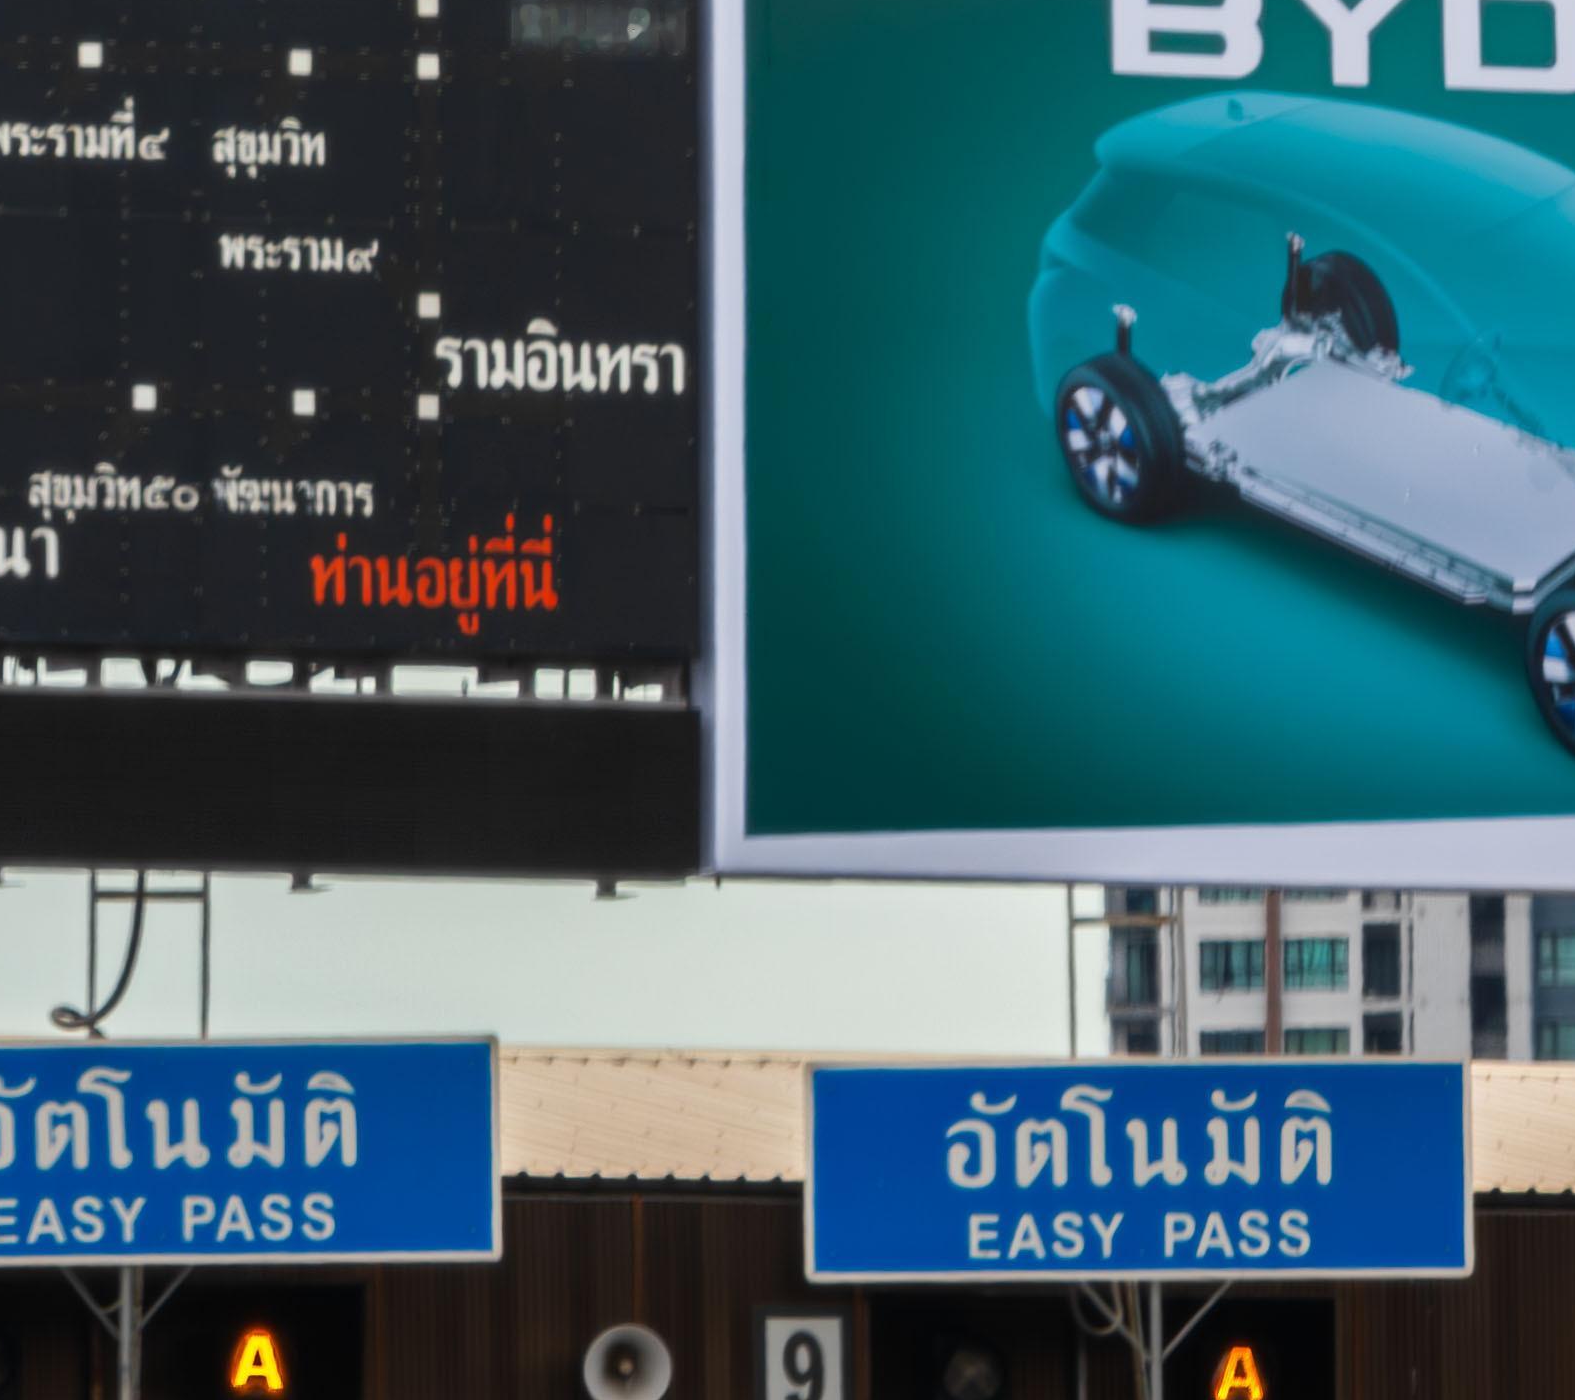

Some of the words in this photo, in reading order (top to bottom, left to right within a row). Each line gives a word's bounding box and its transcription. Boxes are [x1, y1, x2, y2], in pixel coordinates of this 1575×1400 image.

[213, 117, 326, 178] สุขุมวิท
[435, 318, 685, 396] รามอินทรา
[310, 513, 557, 635] ท่านอยู่ที่นี่
[945, 1084, 1333, 1190] อัตโนมัติ
[183, 1194, 337, 1241] PASS
[970, 1213, 1124, 1260] EASY
[1165, 1210, 1312, 1258] PASS
[230, 1330, 284, 1391] A
